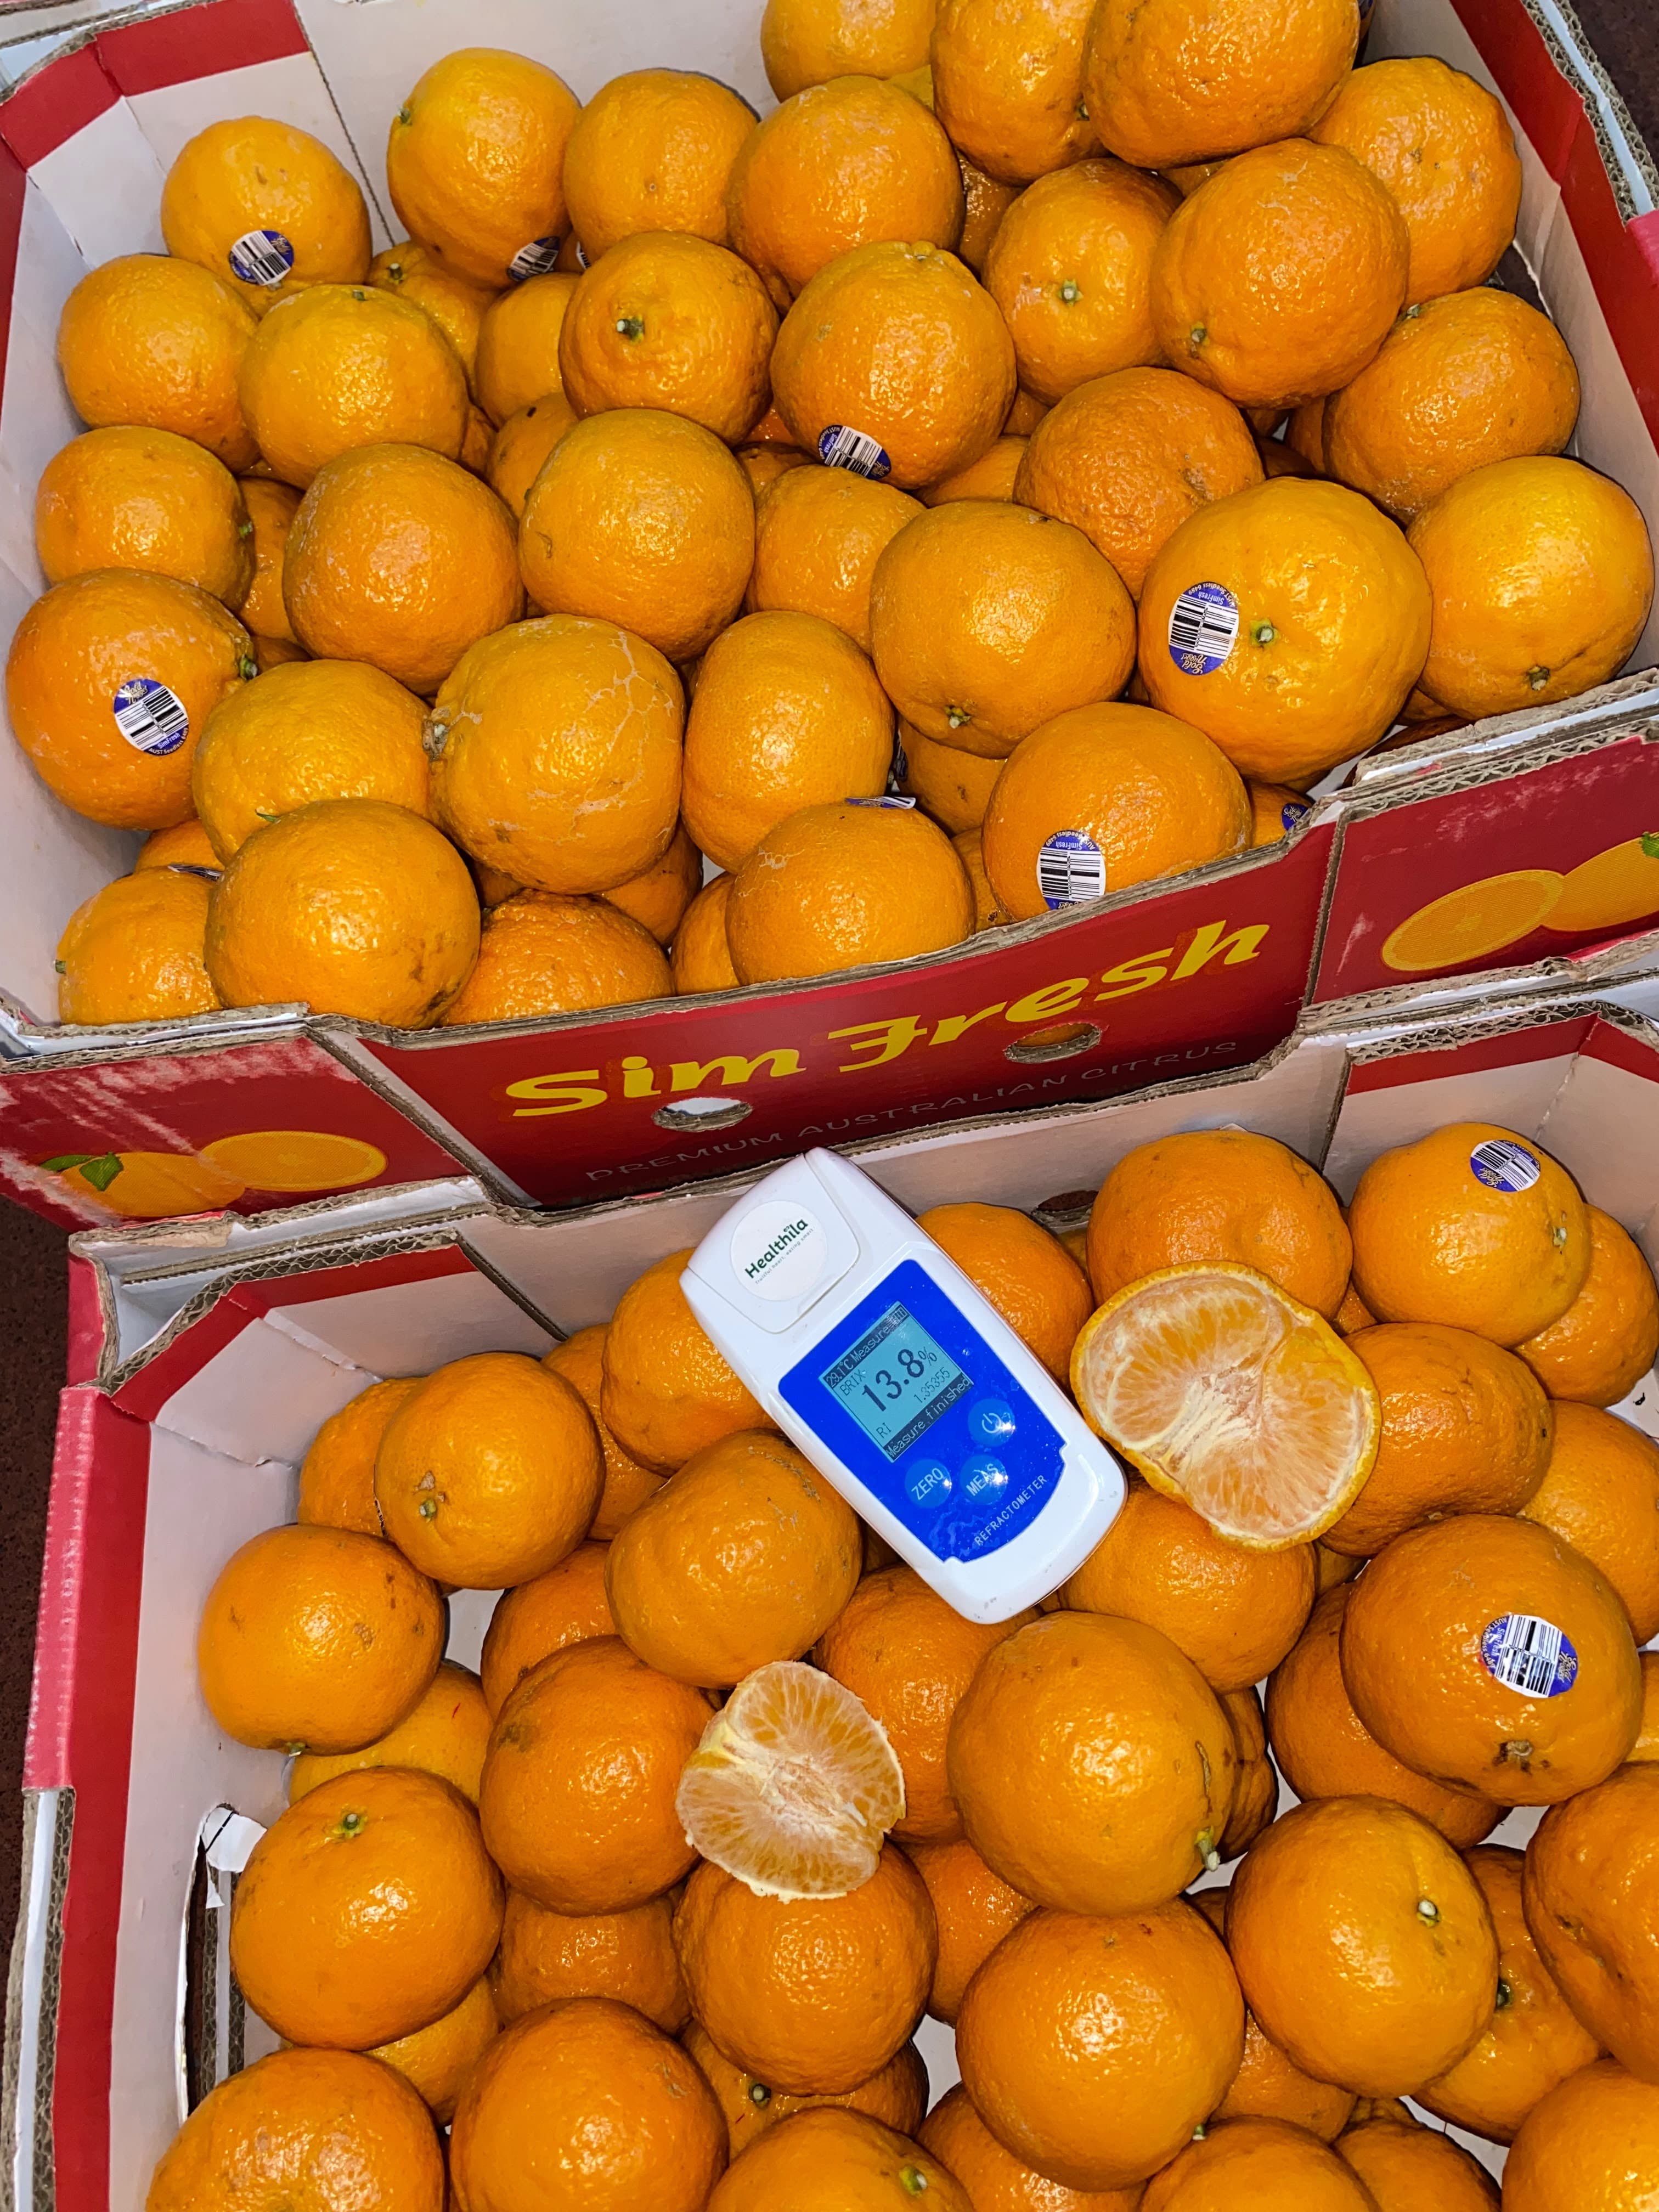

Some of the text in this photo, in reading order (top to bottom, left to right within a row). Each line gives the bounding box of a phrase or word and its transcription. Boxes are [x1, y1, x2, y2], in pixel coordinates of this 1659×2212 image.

[1198, 591, 1225, 605] SimFresh
[157, 732, 181, 749] SimFresh
[1056, 841, 1083, 850] SimFresh
[1057, 831, 1084, 841] eedless
[505, 919, 1269, 1116] Sim Fresh
[585, 1042, 1237, 1181] PREMIUM AUSTRALIAN CITRUS
[744, 1218, 809, 1279] Healthila
[852, 1325, 890, 1362] Measure
[839, 1369, 866, 1396] BRIX
[876, 1366, 950, 1438] RI 1.35355
[885, 1375, 970, 1458] Measure finished
[911, 1463, 999, 1500] ZERO MEAS
[974, 1474, 1048, 1547] REFRACTOMETER
